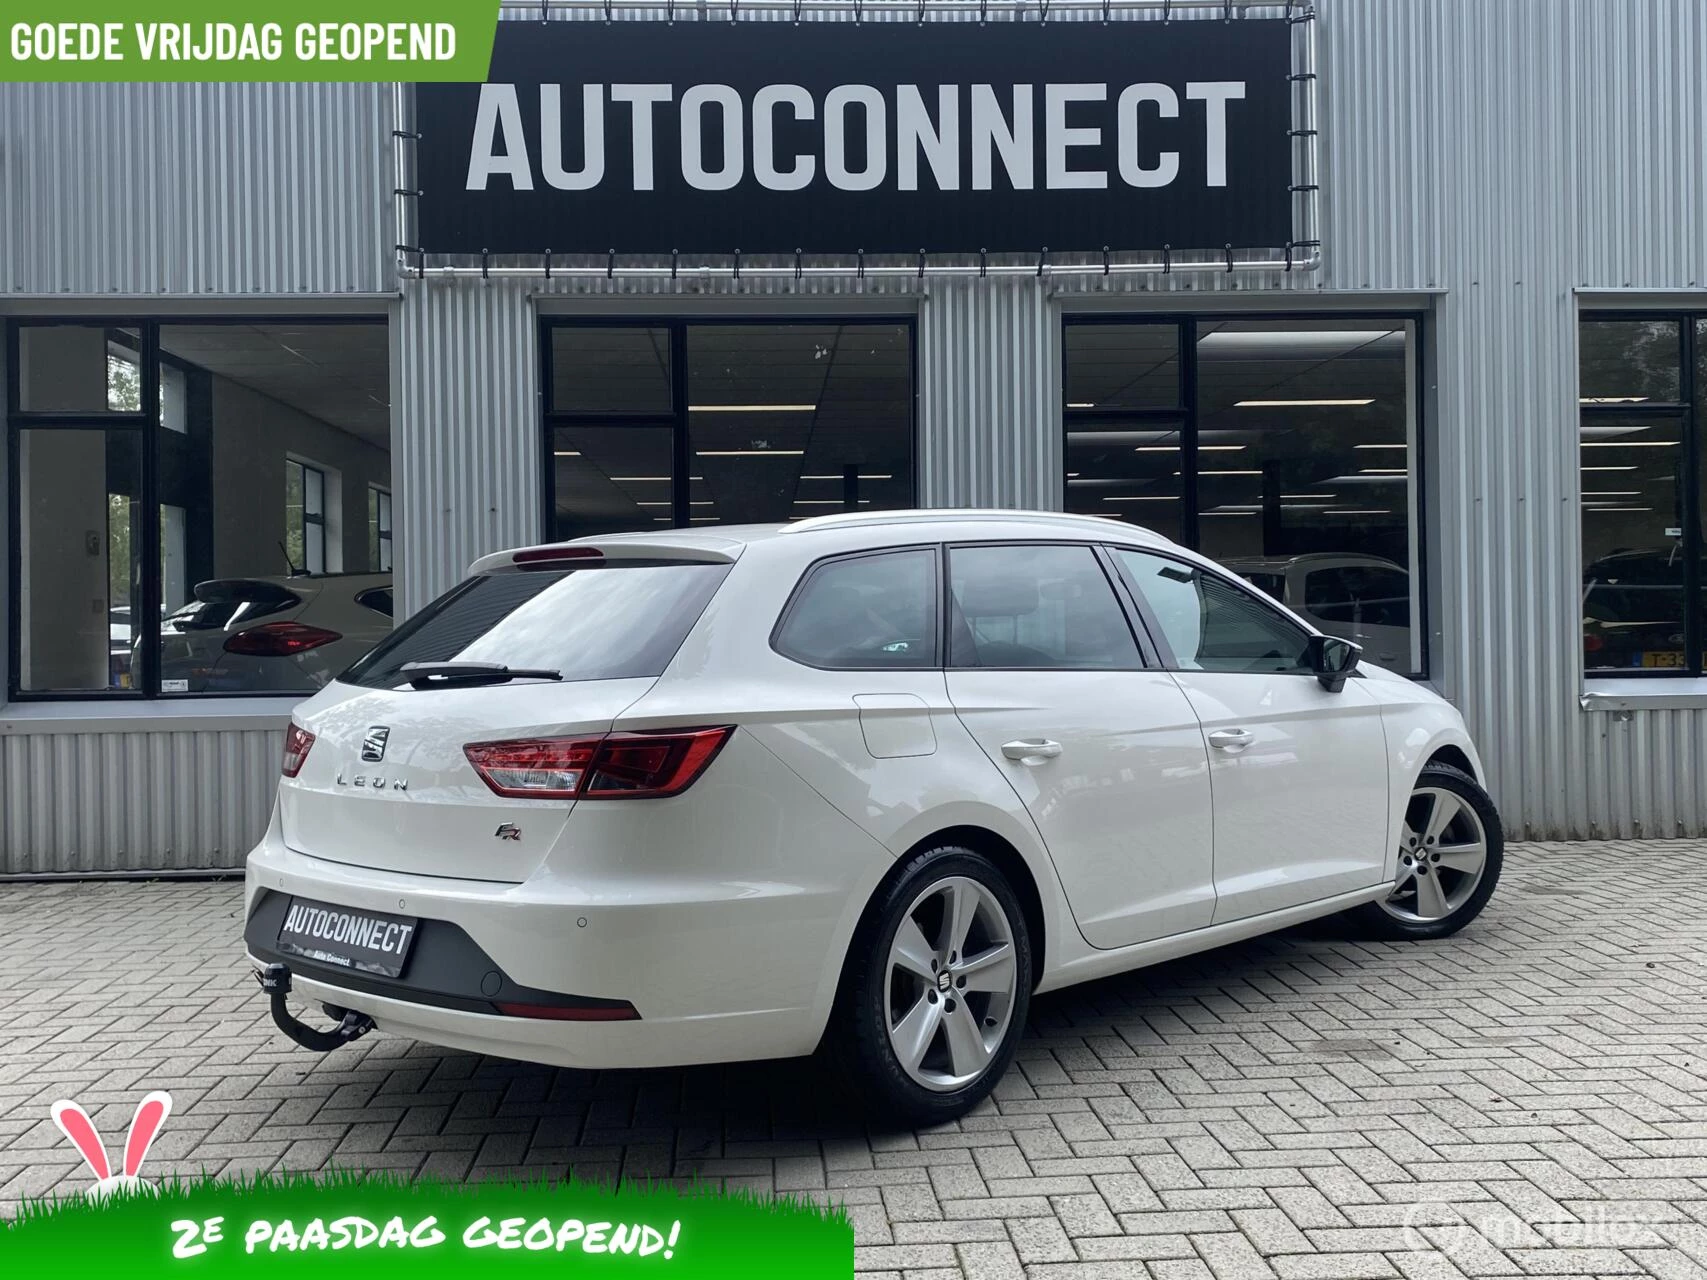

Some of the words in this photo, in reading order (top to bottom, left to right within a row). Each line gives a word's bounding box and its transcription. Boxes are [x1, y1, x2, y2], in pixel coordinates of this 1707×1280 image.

[466, 82, 1246, 191] AUTOCONNECT
[336, 773, 409, 791] LEON
[494, 821, 522, 841] FR
[283, 904, 413, 955] AUTOCONNECT
